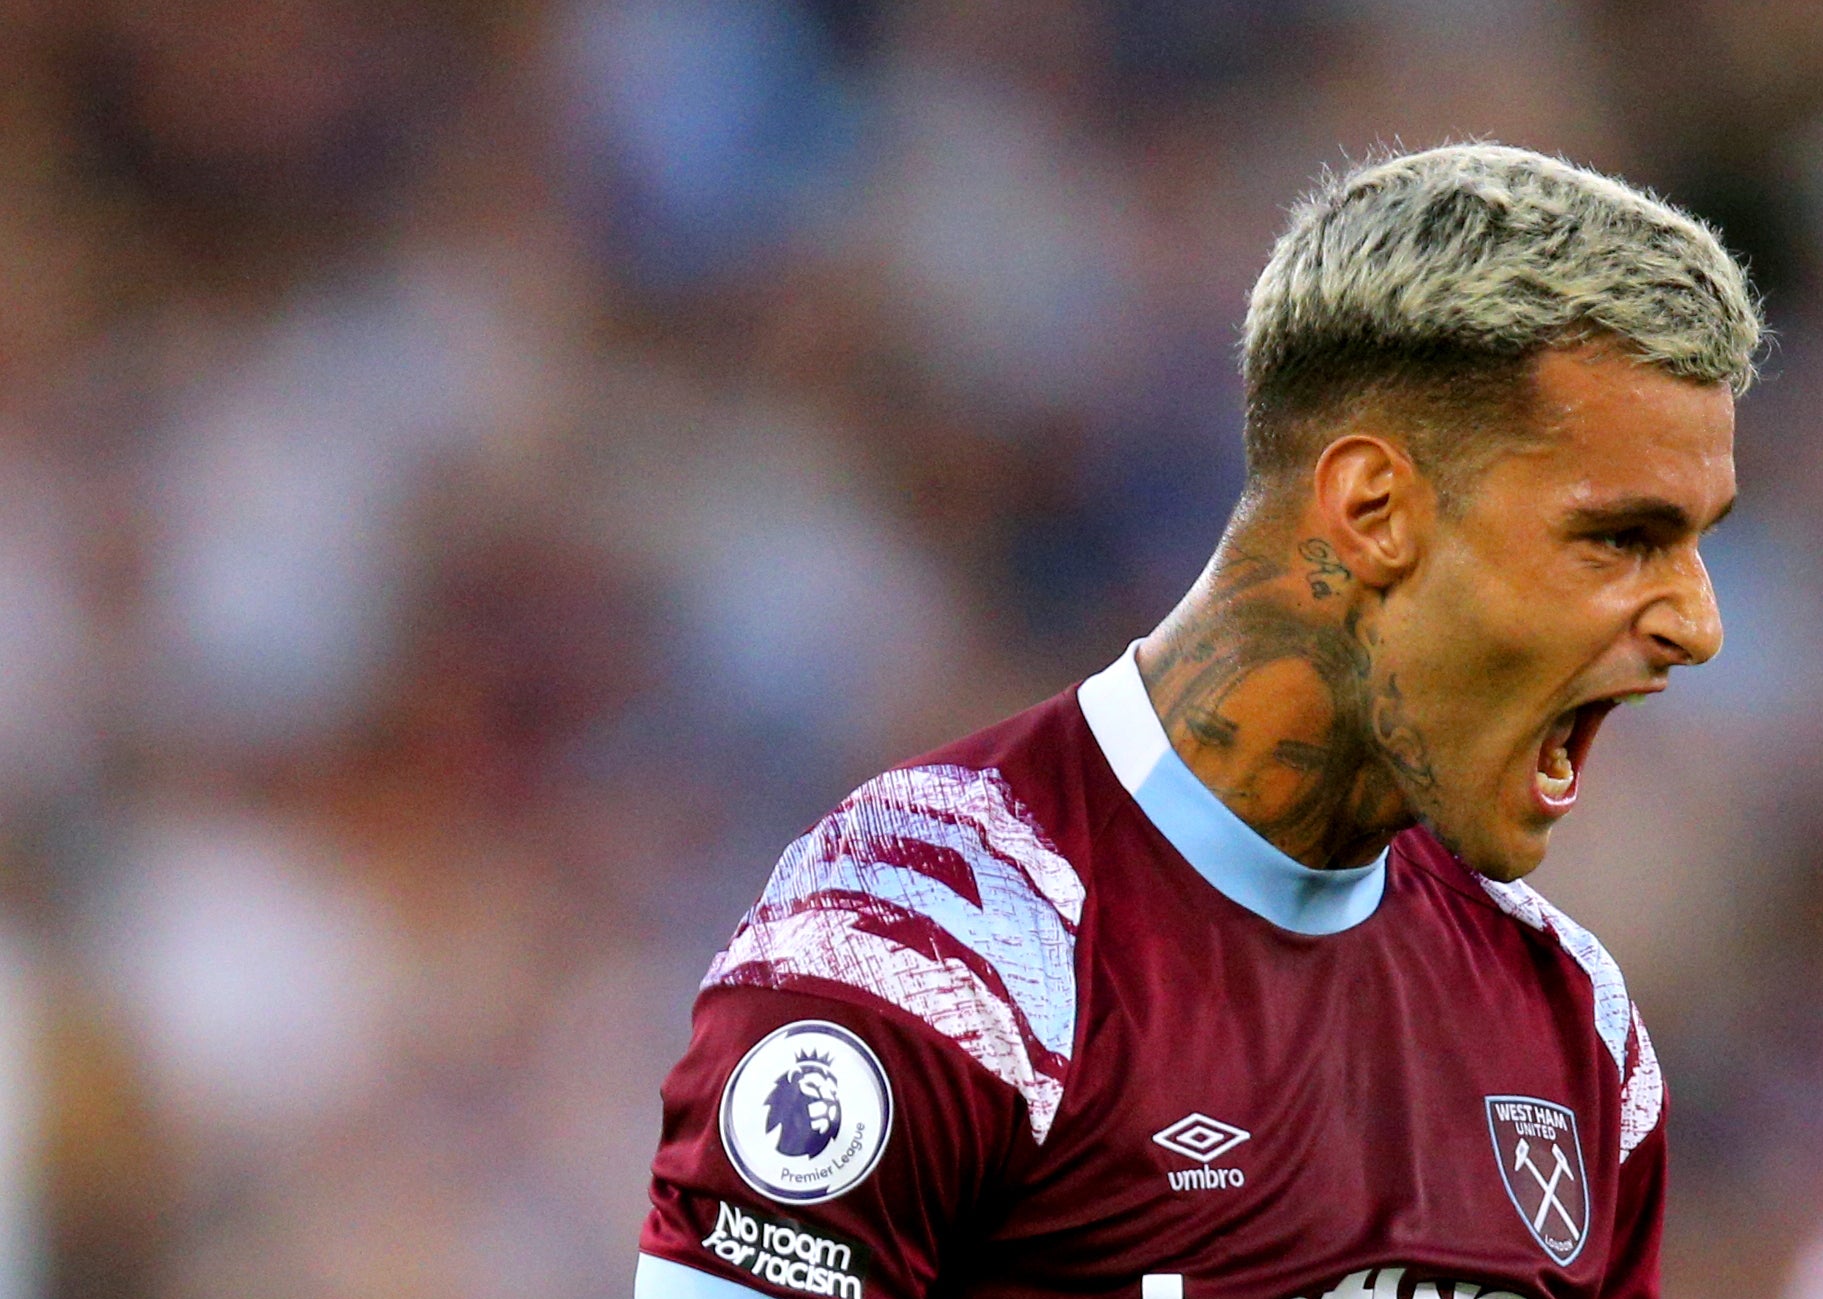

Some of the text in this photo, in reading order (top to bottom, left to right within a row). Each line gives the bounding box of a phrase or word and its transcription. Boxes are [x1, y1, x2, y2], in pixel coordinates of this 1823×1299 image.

[1495, 1103, 1568, 1132] WEST HAM
[1515, 1121, 1557, 1141] UNITED
[780, 1121, 866, 1183] Premier League
[1167, 1163, 1245, 1191] umbro
[714, 1200, 852, 1272] No room
